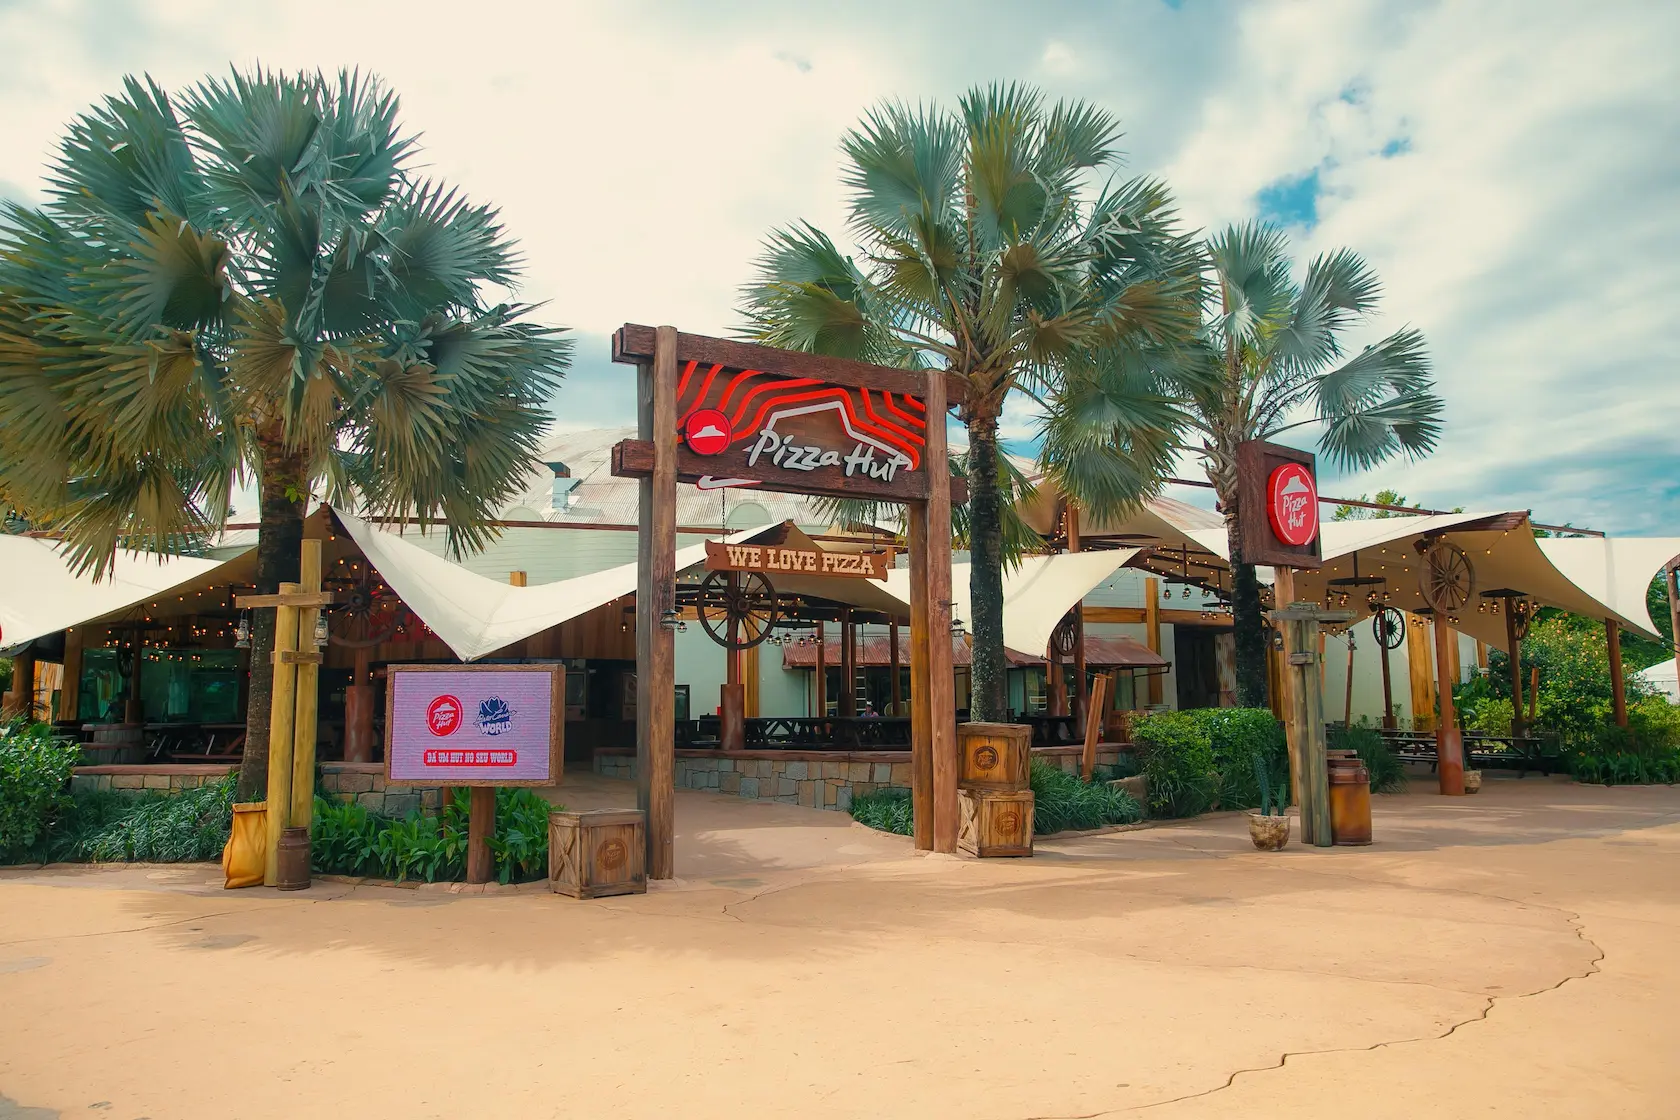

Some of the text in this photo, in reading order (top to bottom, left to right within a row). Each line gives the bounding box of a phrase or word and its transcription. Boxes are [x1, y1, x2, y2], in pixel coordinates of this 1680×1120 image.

[748, 429, 912, 482] Pizza Hut
[1282, 494, 1308, 517] Pizza
[1288, 511, 1306, 531] Hut
[726, 546, 875, 575] WE LOVE PIZZA
[432, 711, 455, 724] Pizza
[436, 719, 453, 730] Hut
[479, 720, 512, 734] WORLD
